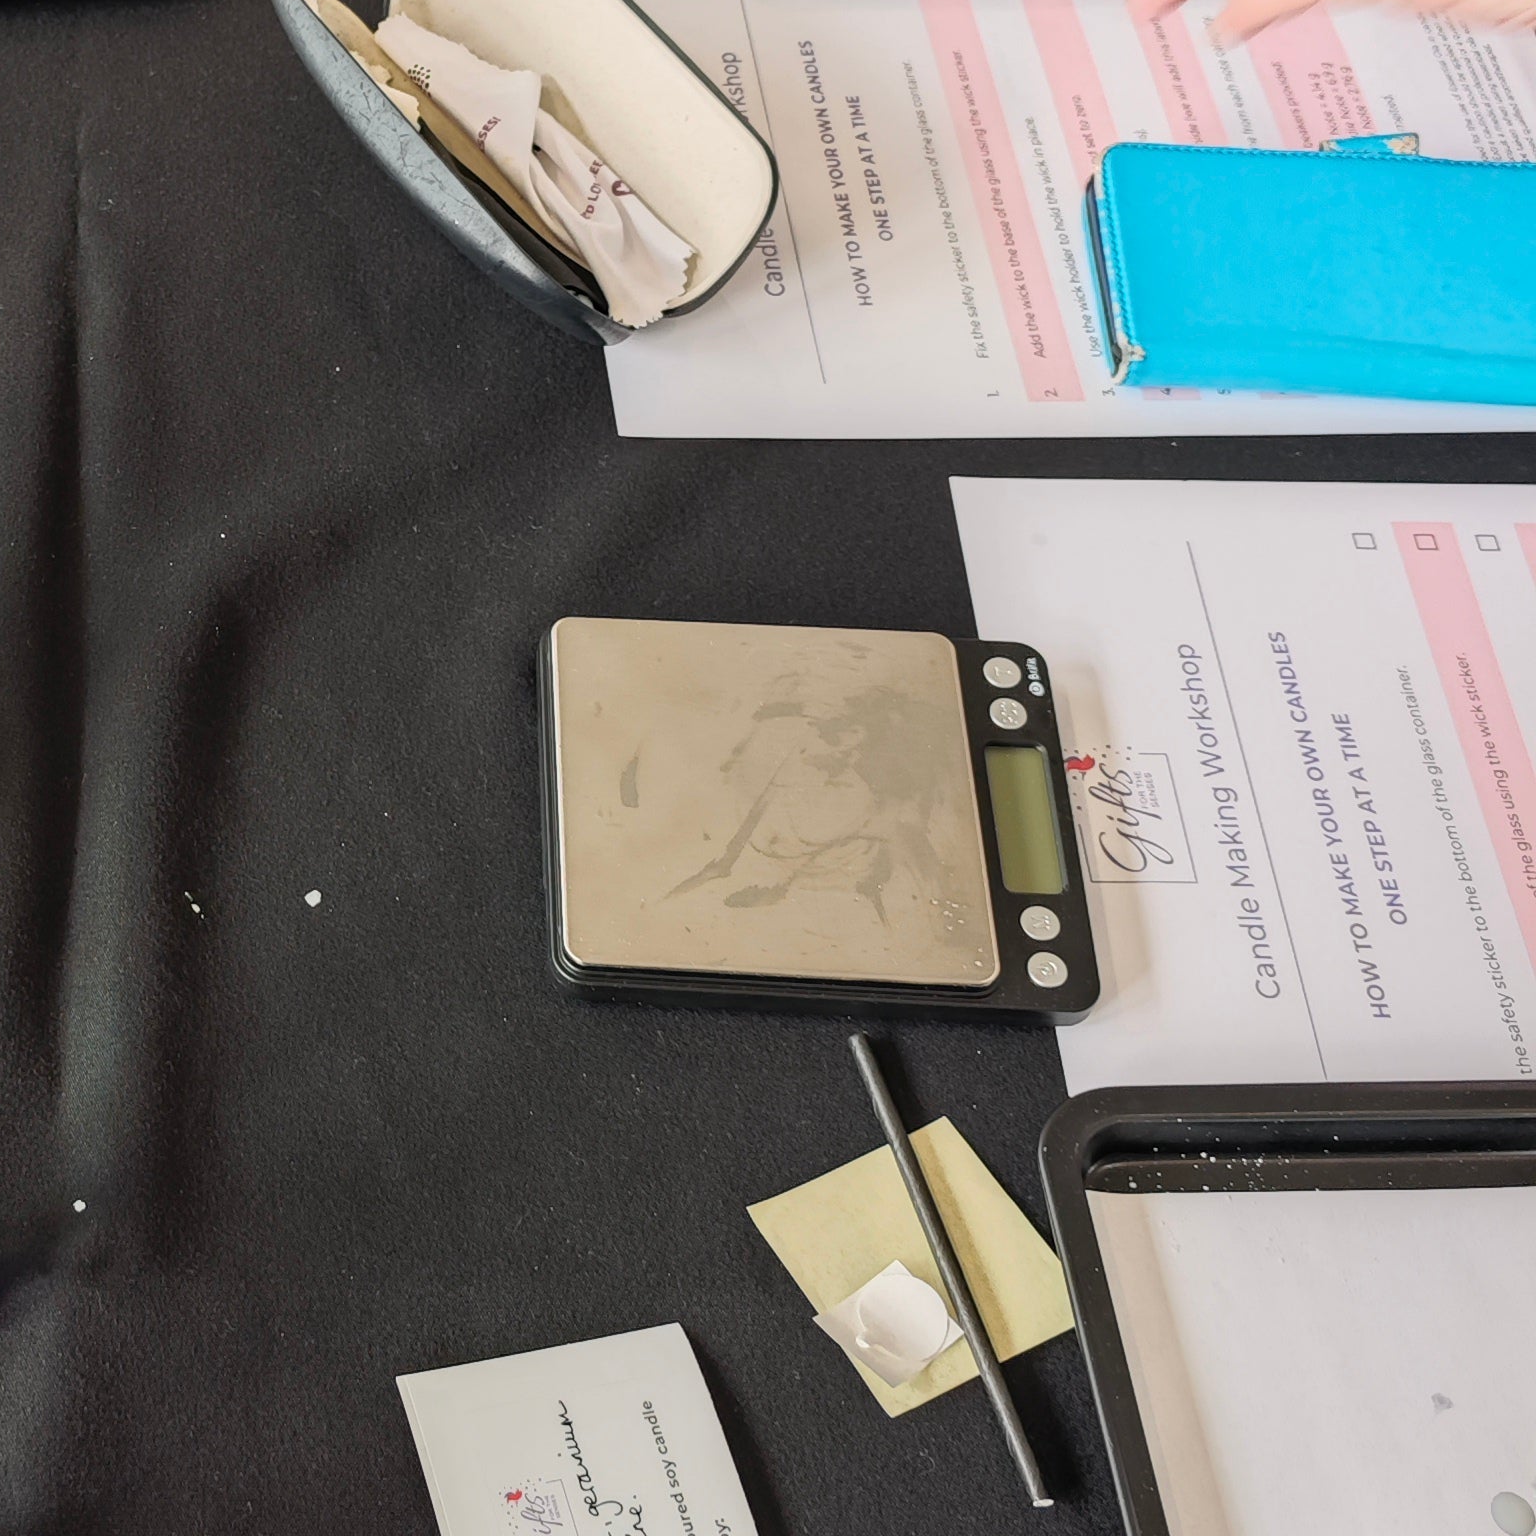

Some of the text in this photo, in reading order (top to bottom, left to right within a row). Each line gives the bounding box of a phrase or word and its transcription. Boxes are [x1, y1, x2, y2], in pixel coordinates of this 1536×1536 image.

[720, 52, 786, 297] Candle rkshop
[797, 39, 874, 306] HOW TO MAKE YOUR OWN CANDLES
[844, 95, 894, 242] ONE STEP AT A TIME
[1455, 652, 1481, 702] sticker.
[1469, 703, 1492, 738] wick
[1483, 740, 1501, 766] the
[1088, 762, 1175, 873] Gifts
[1134, 770, 1149, 809] FOR THE
[1176, 643, 1281, 999] Candle Making Workshop
[1267, 631, 1392, 1019] HOW TO MAKE YOUR OWN CANDLES
[1330, 713, 1408, 925] ONE STEP AT A TIME
[1492, 768, 1516, 810] using
[1395, 664, 1533, 1075] the safety sticker to the bottom of the glass container.
[1506, 812, 1533, 852] glass
[557, 1399, 624, 1517] geranium
[641, 1400, 669, 1455] candle
[520, 1492, 564, 1536] ifts
[661, 1458, 680, 1489] soy
